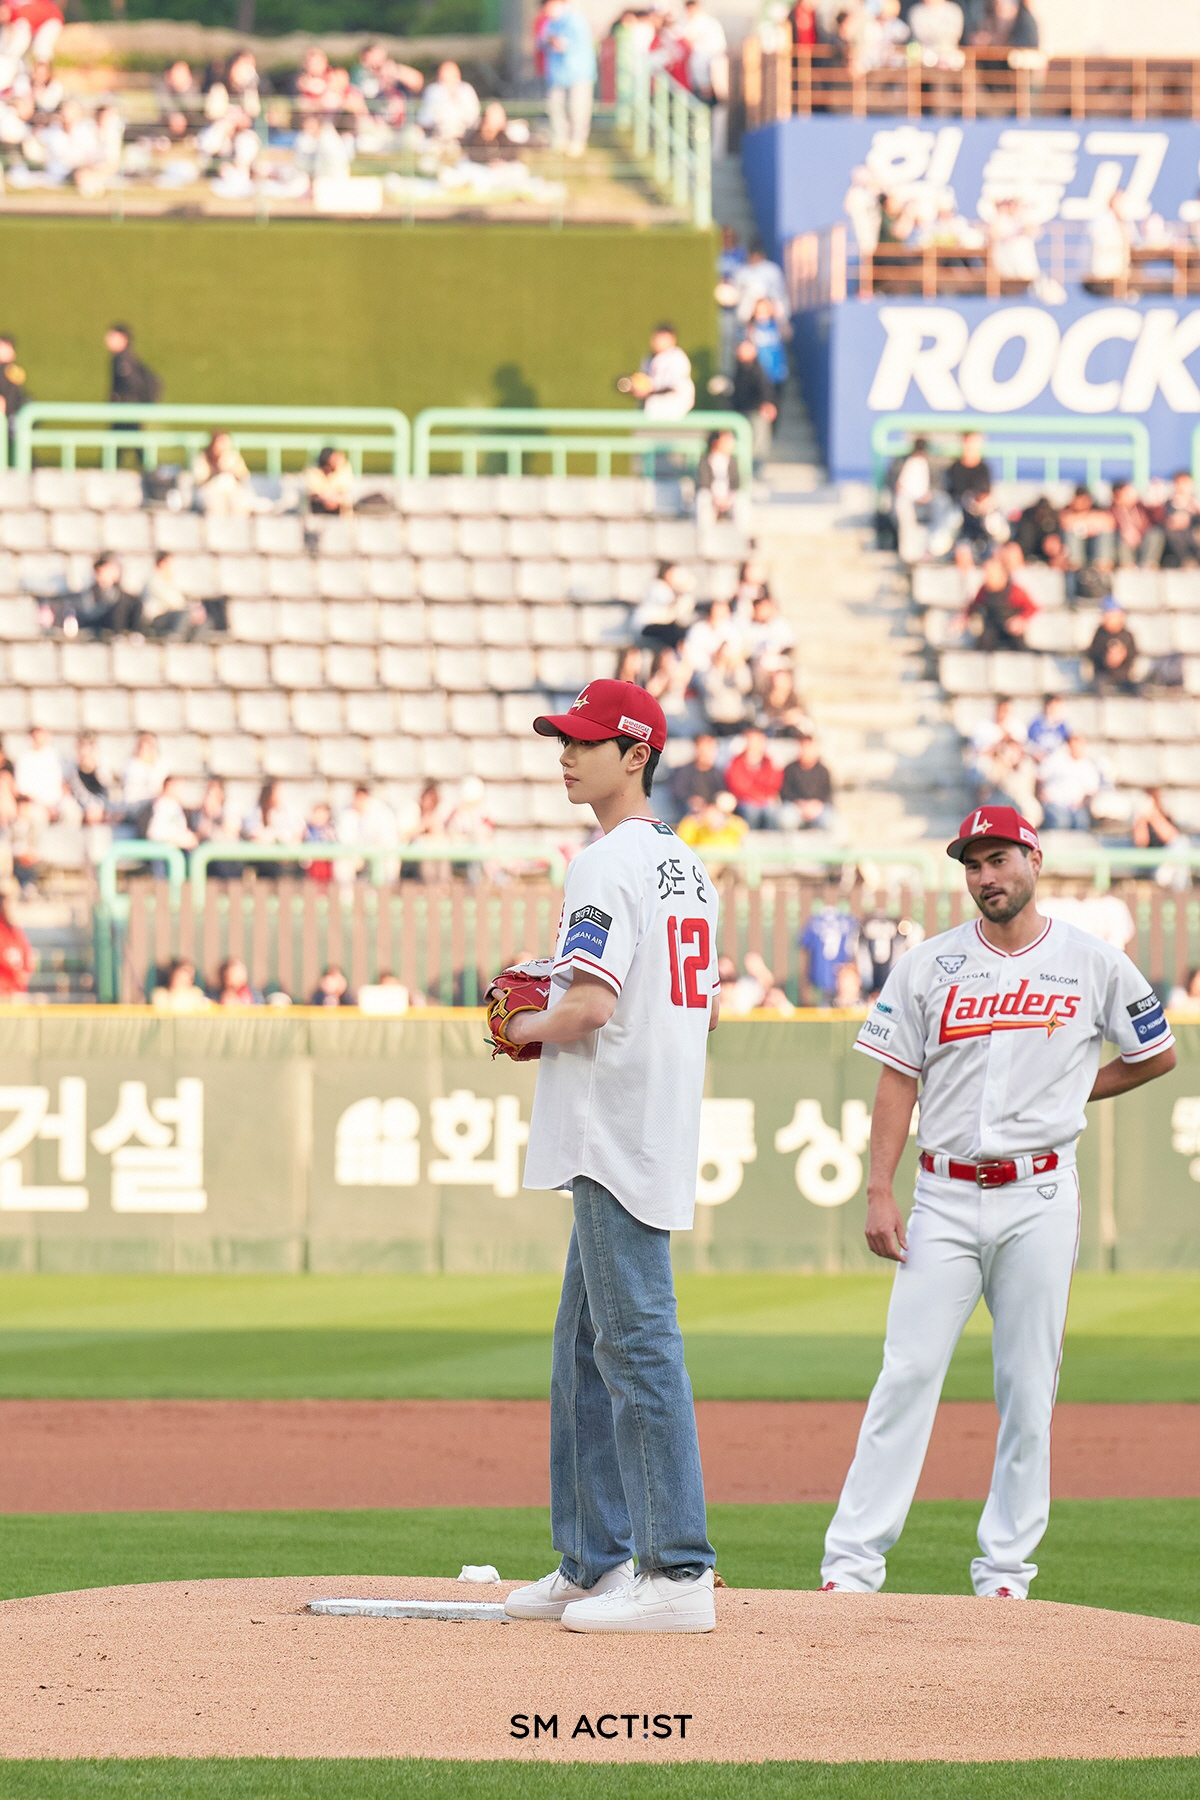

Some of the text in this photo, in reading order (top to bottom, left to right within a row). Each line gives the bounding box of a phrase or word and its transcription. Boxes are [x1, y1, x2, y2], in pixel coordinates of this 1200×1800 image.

[867, 306, 1200, 413] ROCK
[591, 936, 603, 947] AIR
[667, 915, 710, 1009] 12
[938, 978, 1082, 1045] Landers
[1039, 973, 1079, 986] SSG.COM
